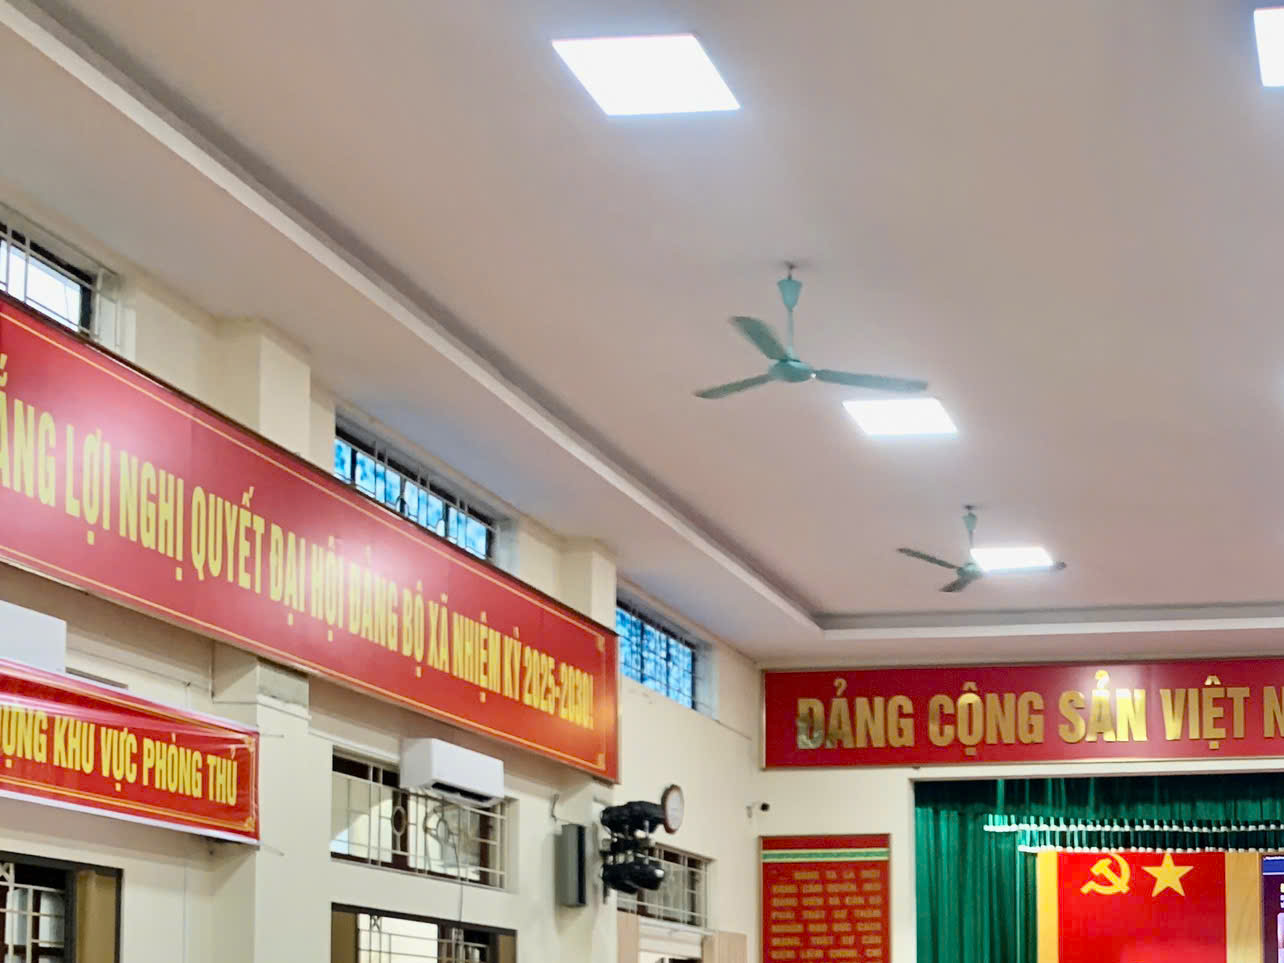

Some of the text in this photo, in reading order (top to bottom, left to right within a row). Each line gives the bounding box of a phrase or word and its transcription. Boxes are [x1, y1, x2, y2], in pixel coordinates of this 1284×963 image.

[65, 423, 111, 545] LỢI
[119, 450, 184, 582] NGHỊ
[191, 486, 265, 594] QUYẾT
[269, 523, 305, 626] ĐẠI
[310, 535, 345, 642] HỘI
[348, 544, 398, 652] ĐẢNG
[402, 580, 425, 678] BỘ
[427, 592, 450, 674] XÃ
[452, 610, 502, 703] NHIỆM
[503, 625, 522, 702] KỲ
[796, 678, 915, 749] ĐẢNG
[928, 682, 1045, 756] CỘNG
[1058, 669, 1147, 743] SẢN
[1159, 675, 1250, 749] VIỆT
[53, 714, 96, 774] KHU
[100, 727, 138, 792] VỰC
[142, 732, 203, 798] PHÒNG
[206, 745, 238, 807] THỦ
